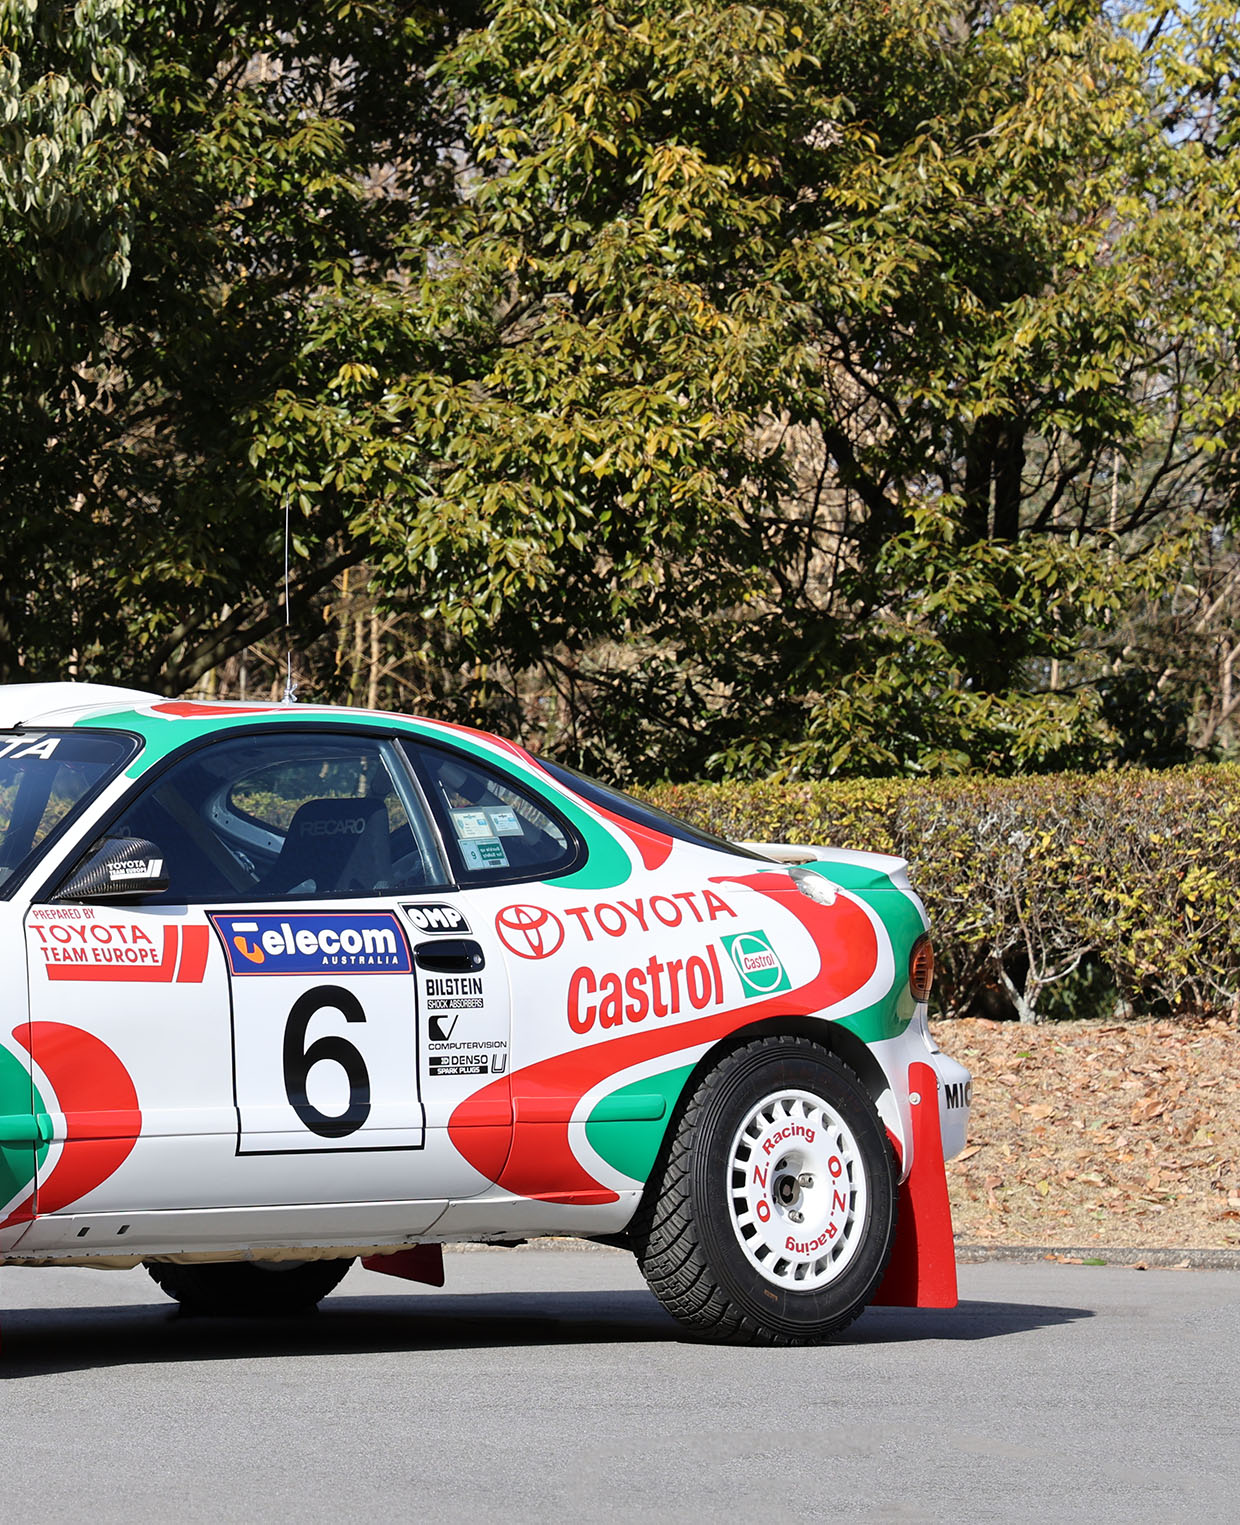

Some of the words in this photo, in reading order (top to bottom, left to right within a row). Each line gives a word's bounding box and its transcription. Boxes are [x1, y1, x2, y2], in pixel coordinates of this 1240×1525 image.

[299, 817, 366, 838] RECARO
[107, 860, 146, 870] TOYOTA
[32, 908, 81, 920] PREPARED
[82, 908, 96, 919] BY
[407, 907, 462, 928] OMP
[564, 889, 738, 942] TOYOTA
[28, 924, 153, 944] TOYOTA
[40, 947, 89, 962] TEAM
[93, 948, 160, 963] EUROPE
[321, 955, 399, 965] AUSTRALIA
[743, 953, 775, 971] Castrol
[426, 978, 482, 996] BILSTEIN
[567, 944, 724, 1035] Castrol
[428, 1000, 448, 1009] SHOCK
[449, 999, 483, 1009] ABSORBERS
[428, 1041, 507, 1050] COMPUTERVISION
[283, 985, 371, 1138] 6
[451, 1054, 489, 1066] DENSO
[436, 1067, 458, 1075] SPARK
[459, 1066, 480, 1074] PLUGS
[761, 1122, 816, 1157] Racing
[785, 1221, 838, 1256] Racing
